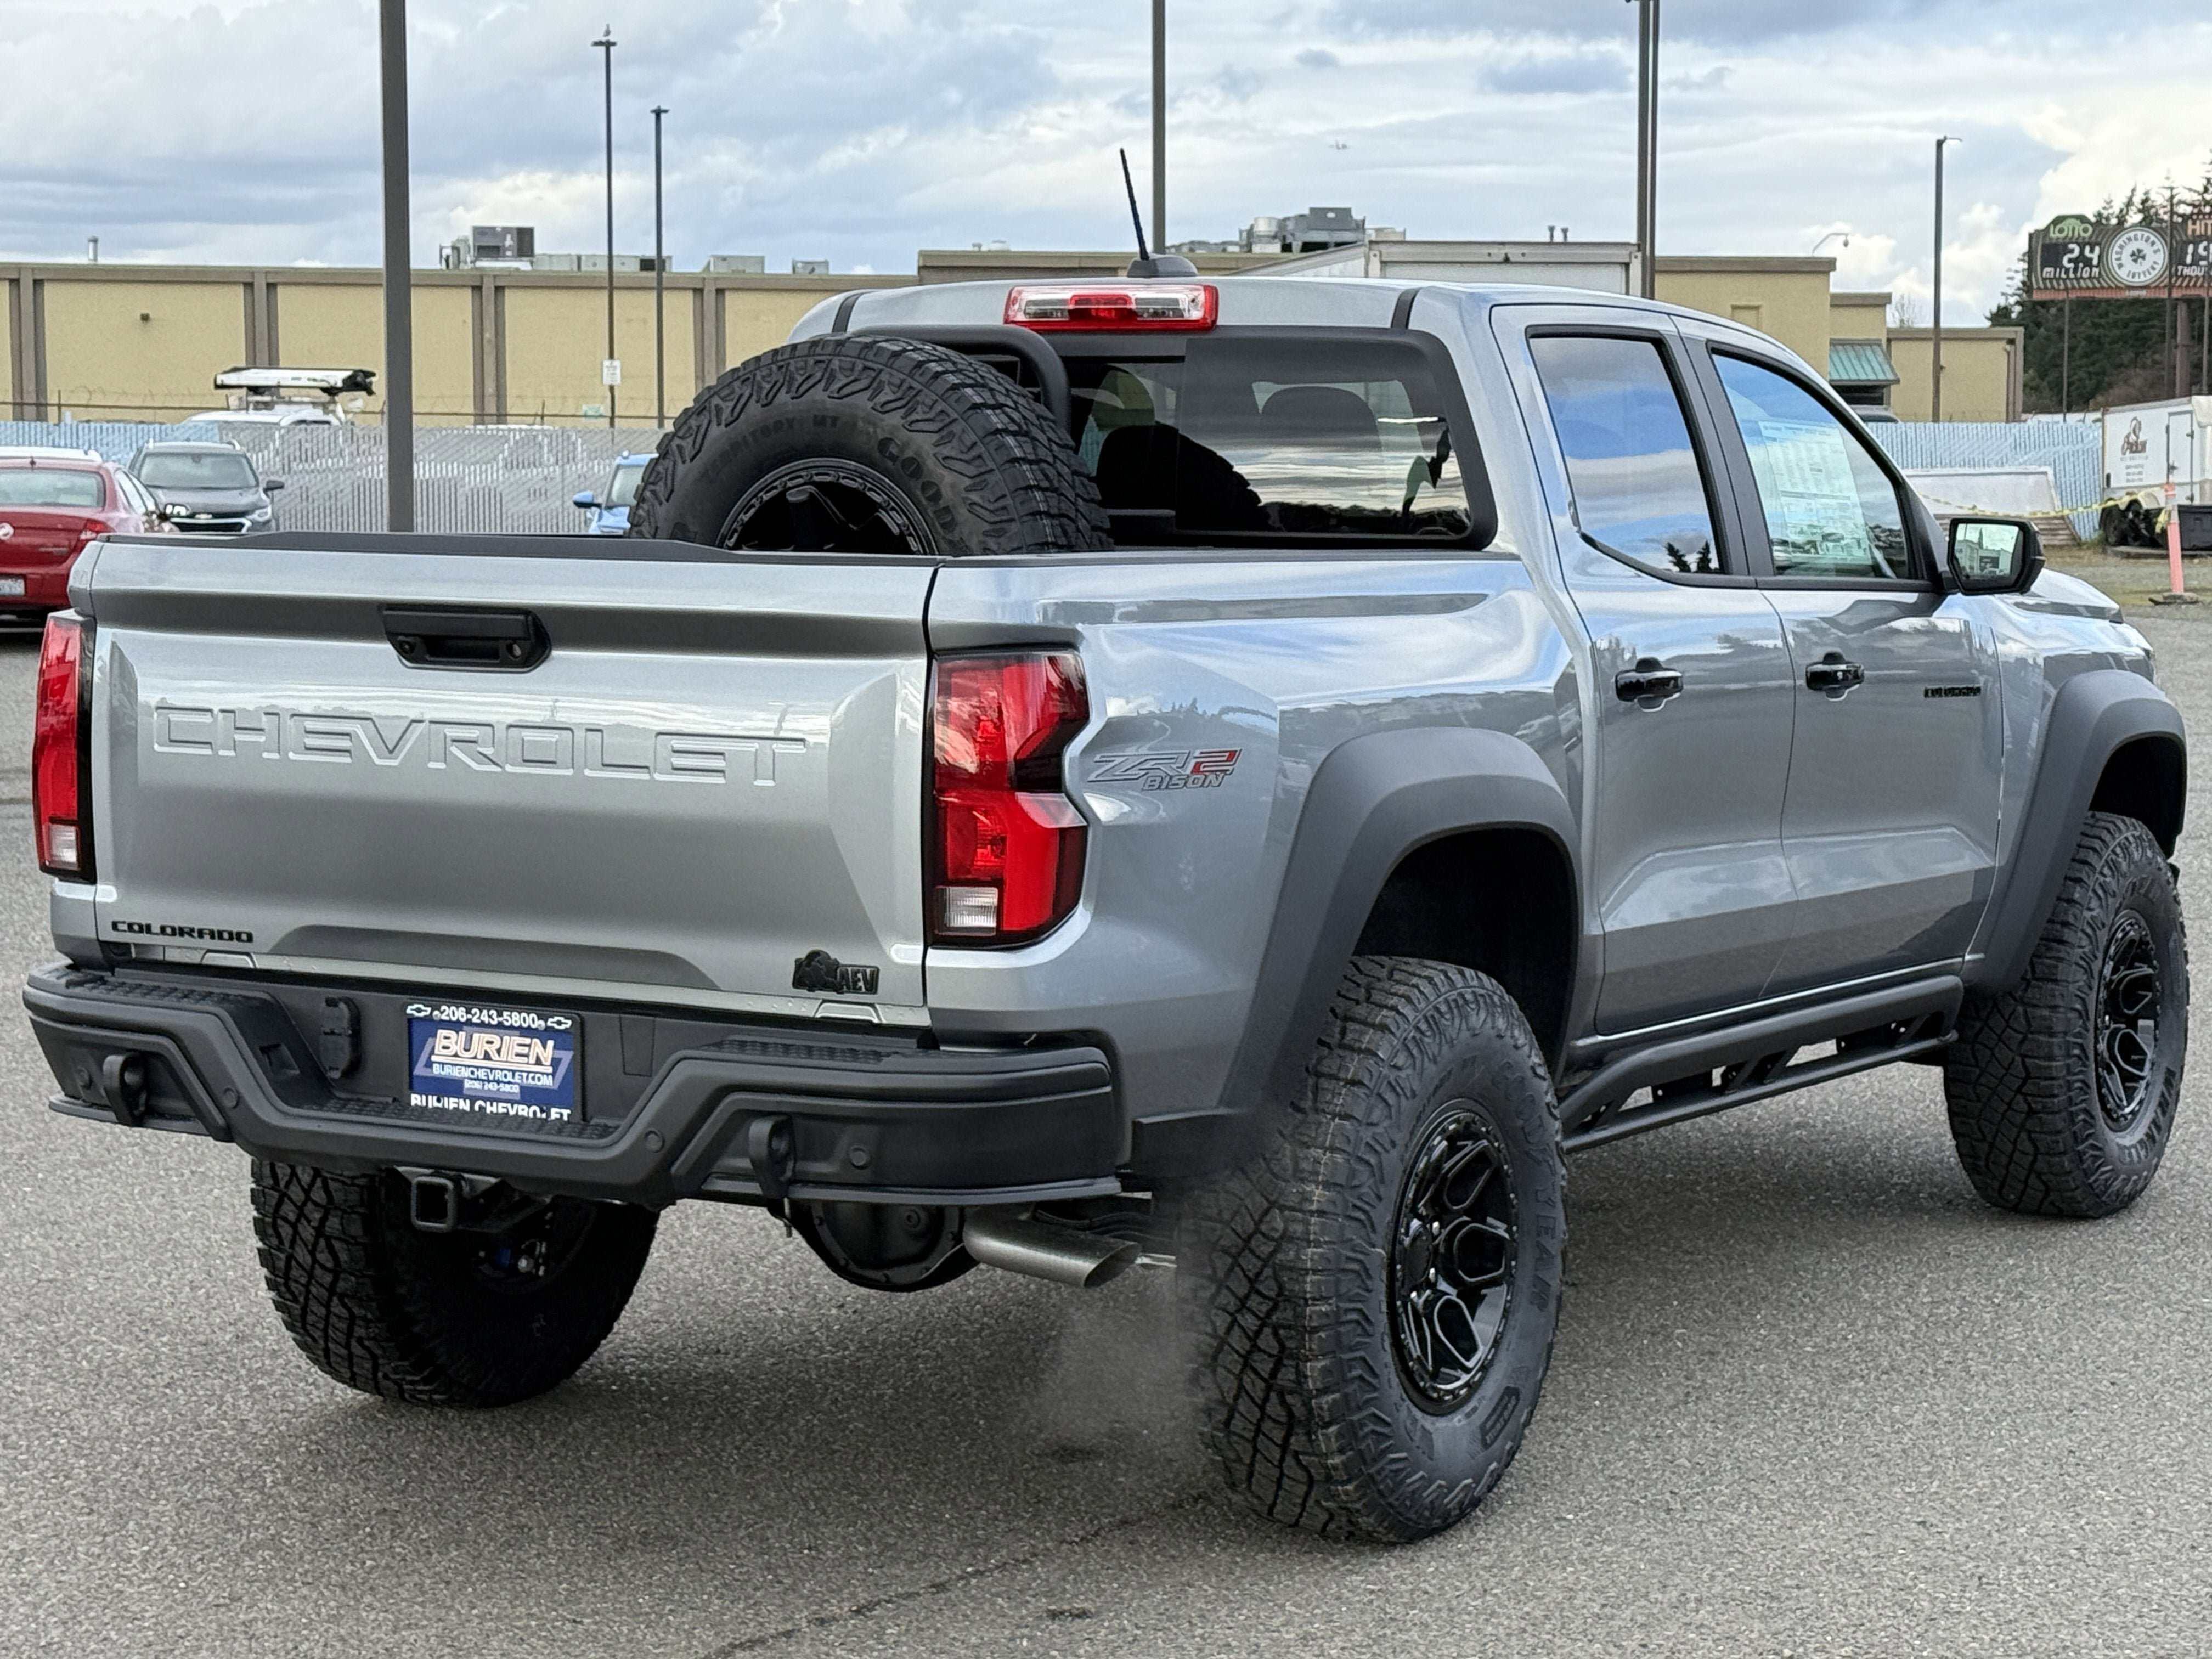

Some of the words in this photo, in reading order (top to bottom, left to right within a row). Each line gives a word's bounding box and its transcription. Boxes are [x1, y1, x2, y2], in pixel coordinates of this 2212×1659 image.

[2050, 219, 2093, 238] LOTTO
[2062, 243, 2101, 268] 24
[2042, 263, 2100, 279] MILLION
[153, 706, 808, 786] CHEVROLET
[1087, 748, 1242, 782] ZR2
[1142, 773, 1226, 791] BISON
[111, 920, 253, 943] COLORADO
[838, 967, 876, 992] AEV
[440, 1005, 538, 1028] 206-243-5800
[434, 1029, 555, 1066] BURIEN
[432, 1063, 553, 1086] BURIENCHEVROLET.COM
